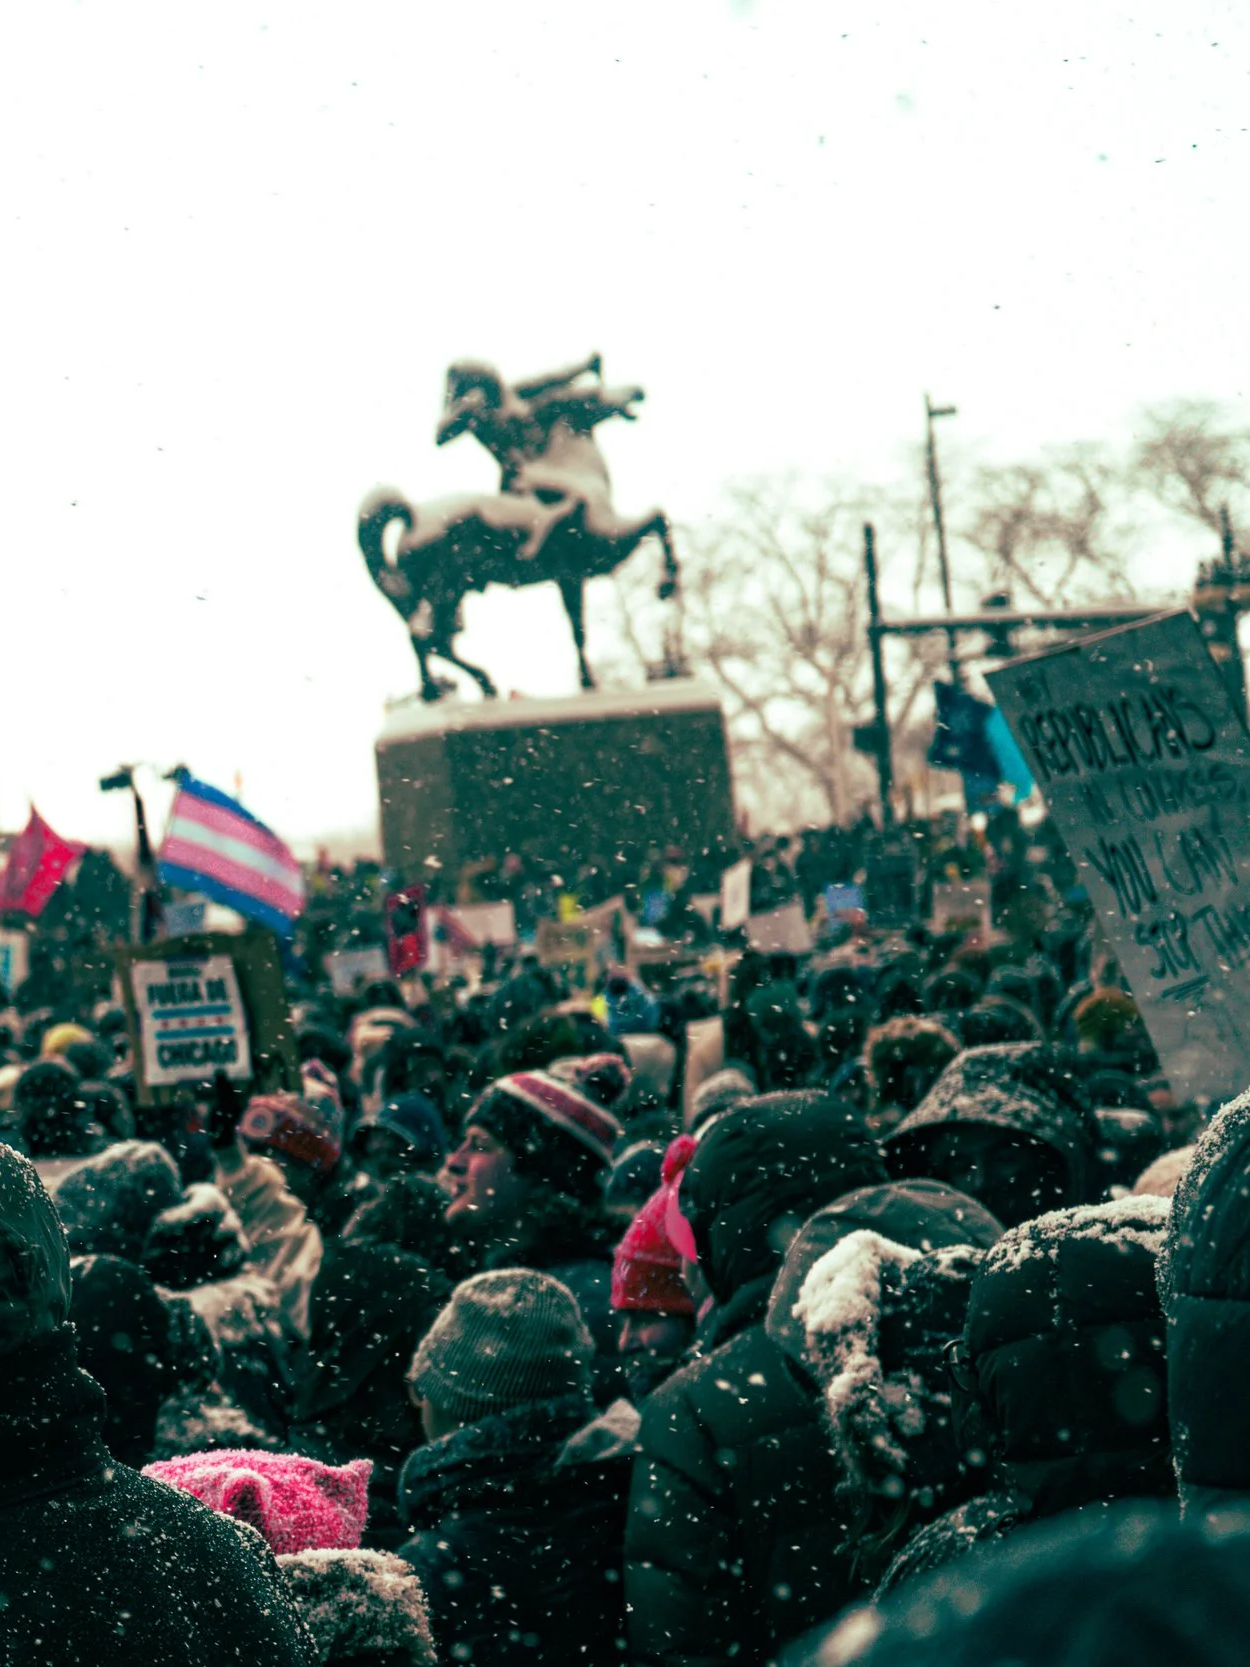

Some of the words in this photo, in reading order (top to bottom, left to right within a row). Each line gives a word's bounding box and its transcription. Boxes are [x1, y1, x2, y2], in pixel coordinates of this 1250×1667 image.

[1018, 686, 1216, 782] REPUBLICANS
[1084, 834, 1158, 919] YOU
[157, 1039, 238, 1069] CHICAGO
